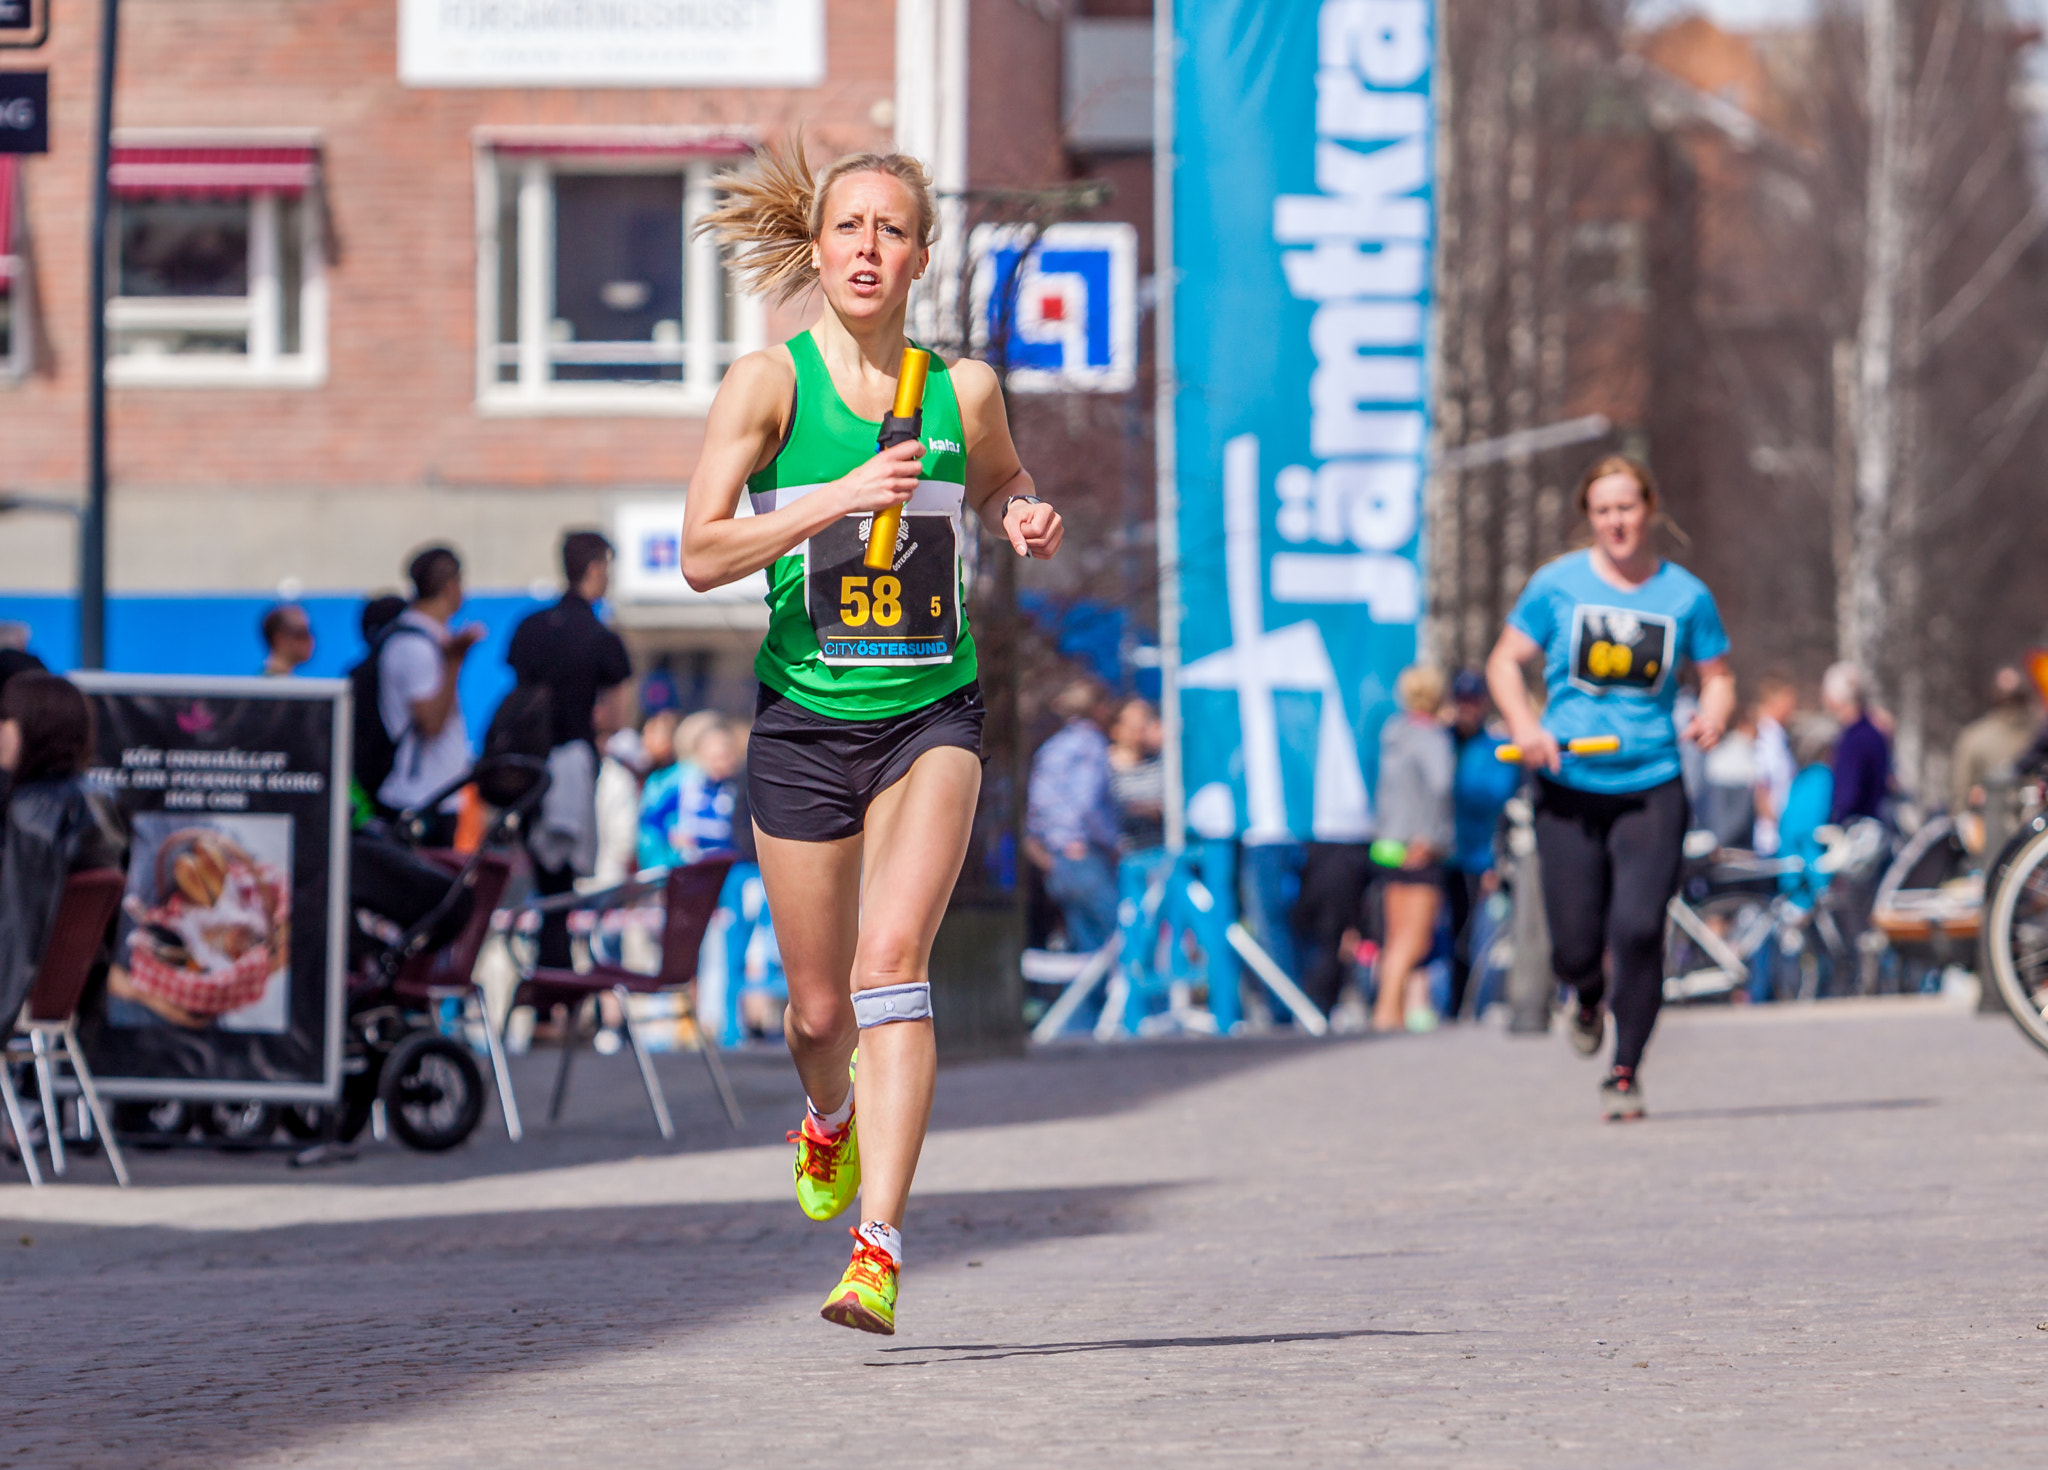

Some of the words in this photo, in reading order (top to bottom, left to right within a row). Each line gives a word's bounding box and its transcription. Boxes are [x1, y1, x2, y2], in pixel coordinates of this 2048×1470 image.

[892, 541, 919, 572] ÖSTERSUND
[840, 575, 902, 627] 58
[930, 596, 942, 618] 5
